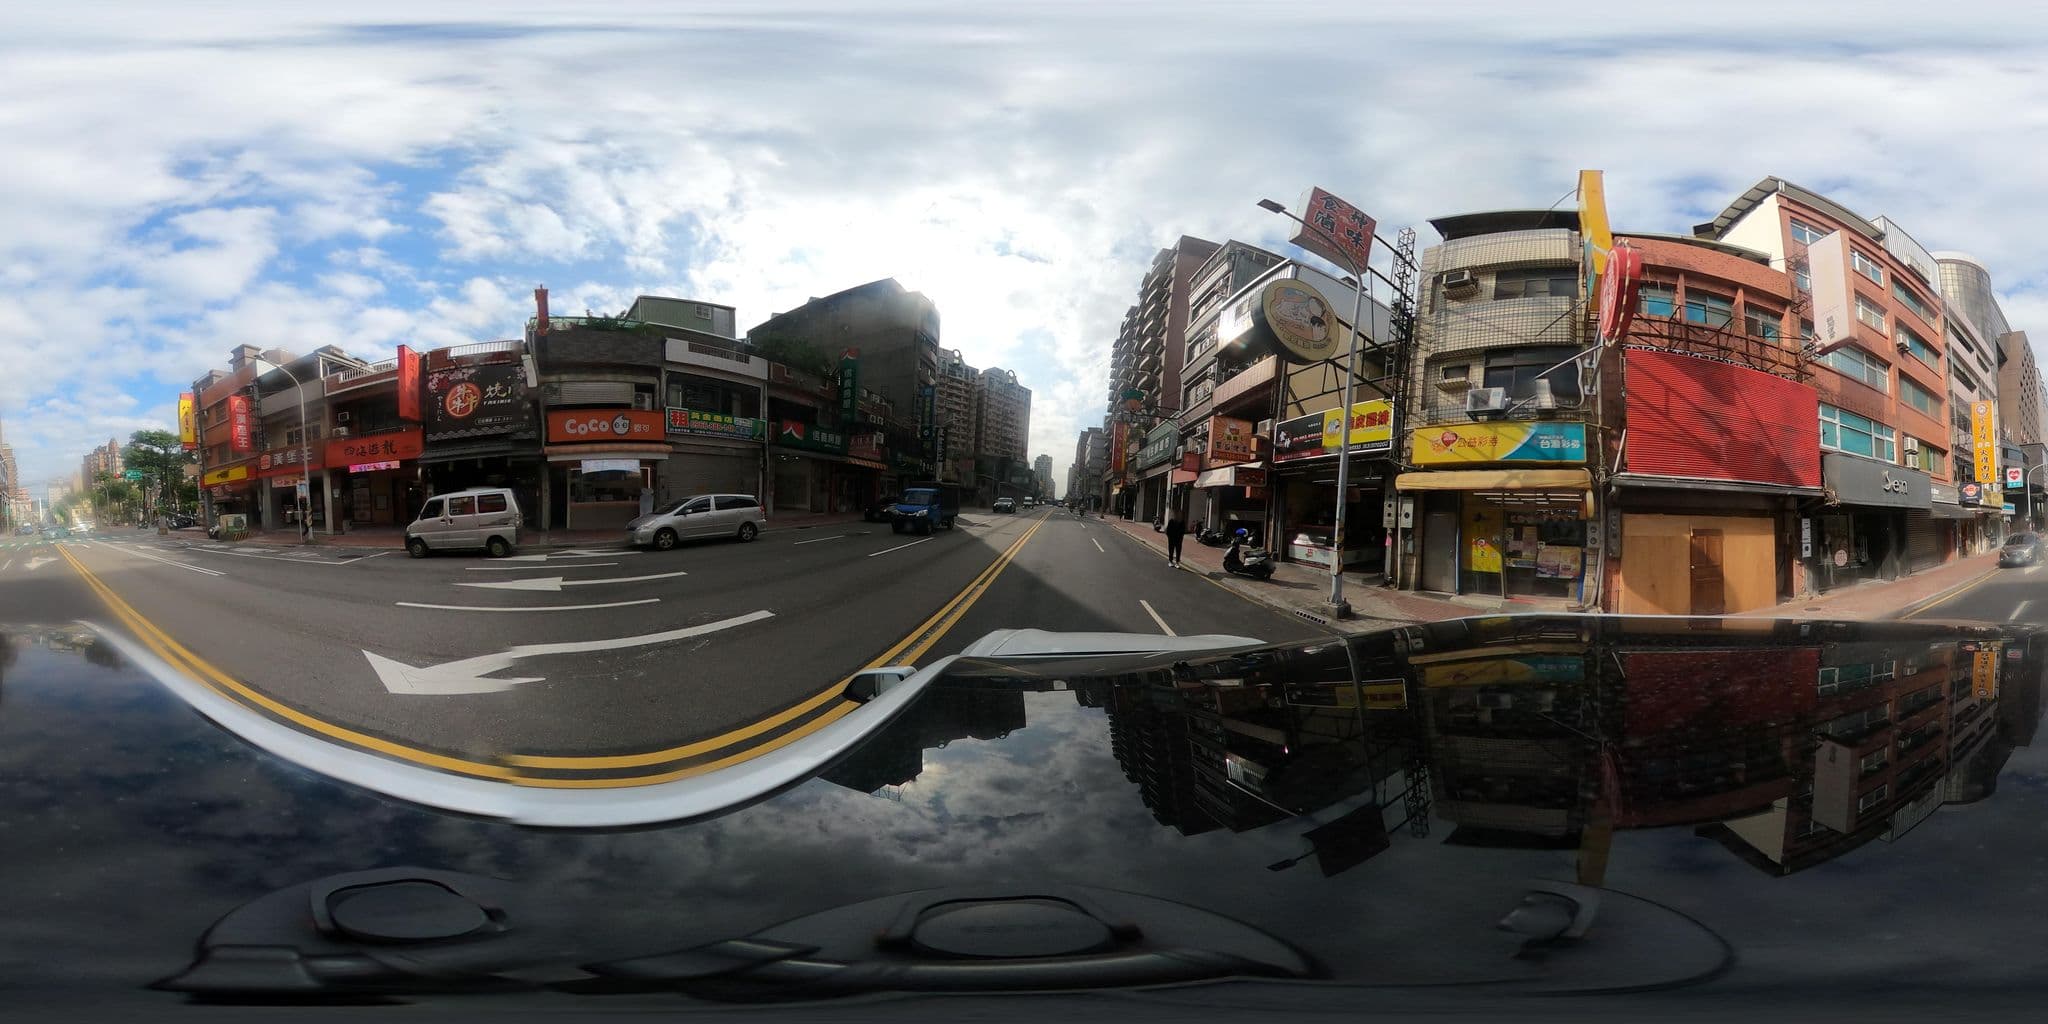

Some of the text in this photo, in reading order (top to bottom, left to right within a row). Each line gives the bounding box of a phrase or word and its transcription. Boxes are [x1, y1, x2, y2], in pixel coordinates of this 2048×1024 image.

[565, 419, 610, 435] CoCo
[671, 409, 689, 427] 租
[235, 413, 249, 448] 漢堡王
